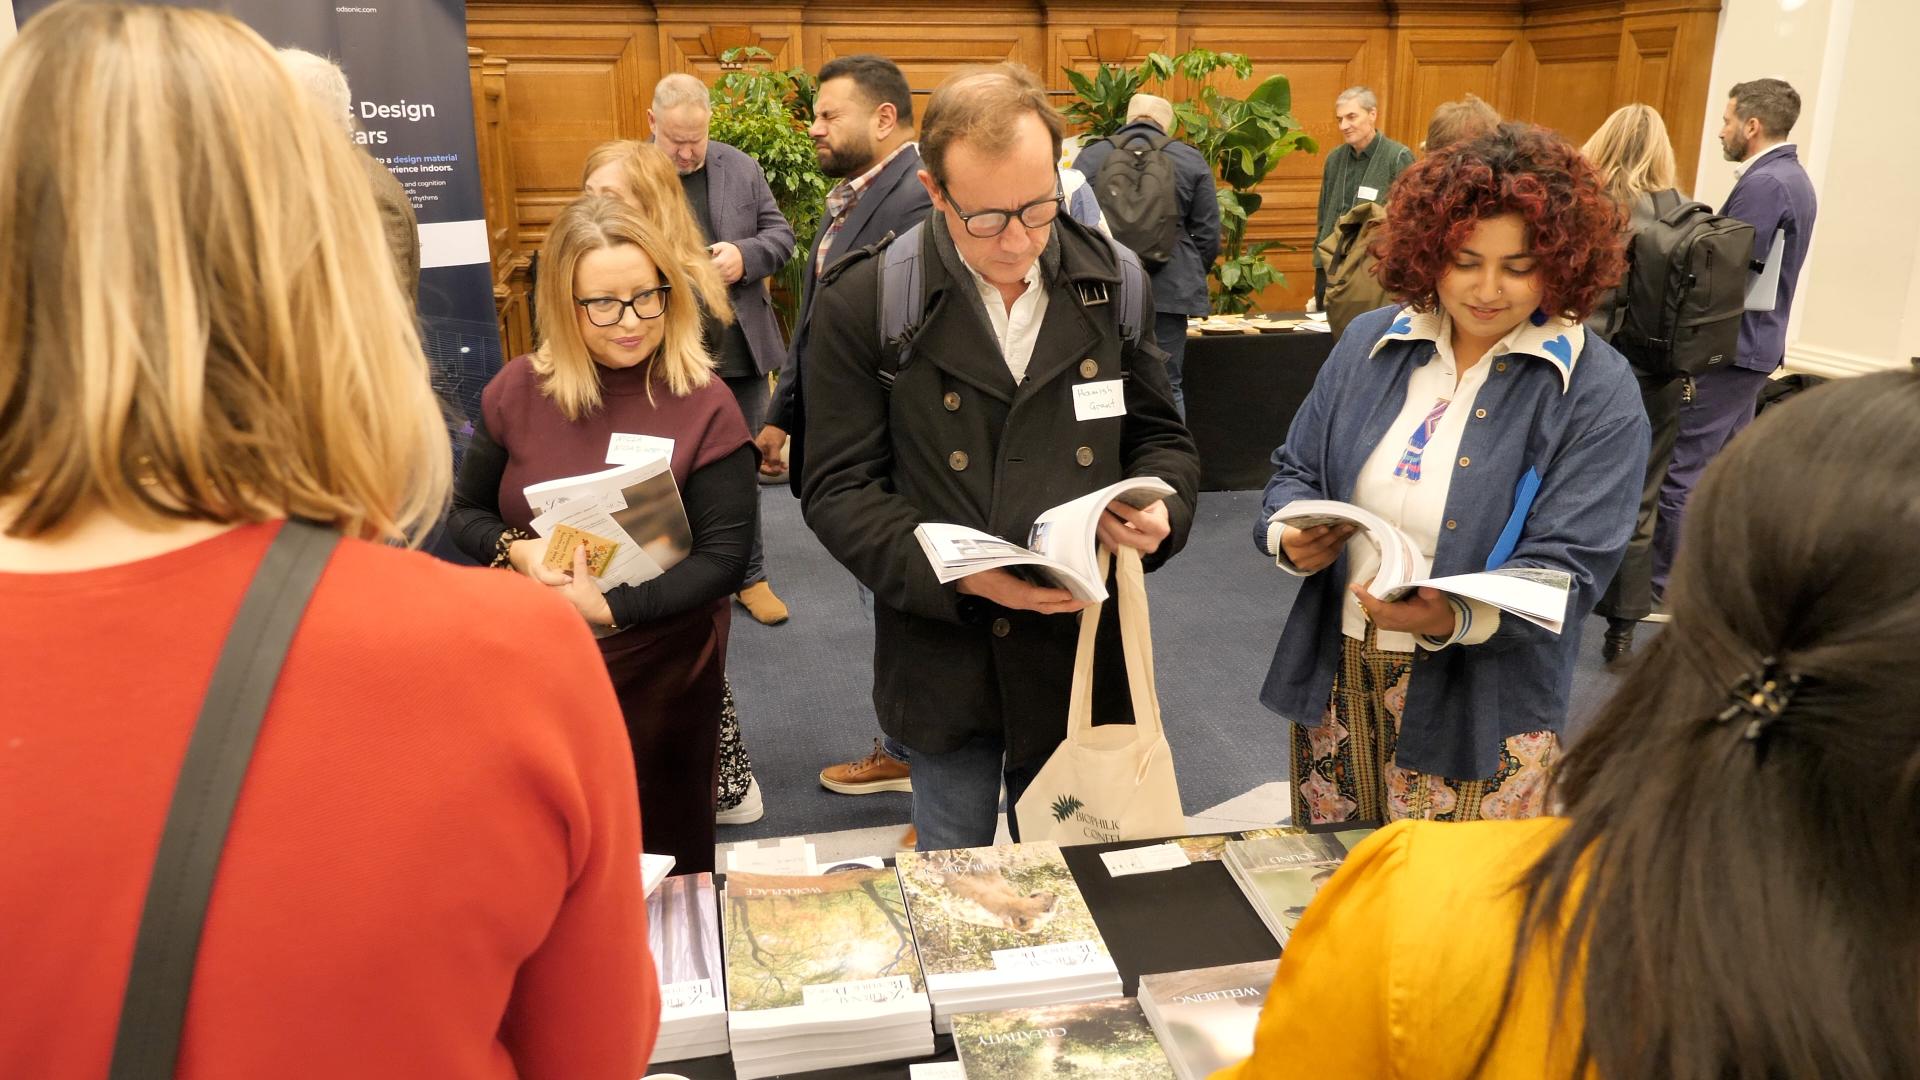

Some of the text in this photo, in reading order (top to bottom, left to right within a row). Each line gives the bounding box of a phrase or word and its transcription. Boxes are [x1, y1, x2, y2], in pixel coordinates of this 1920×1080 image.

[360, 99, 435, 121] Design
[393, 154, 422, 165] design
[423, 153, 458, 162] material
[420, 164, 454, 172] indoors.
[744, 886, 824, 897] WORKPLACE
[1172, 986, 1260, 1005] WELLBEING
[978, 1027, 1067, 1046] CREATIVITY
